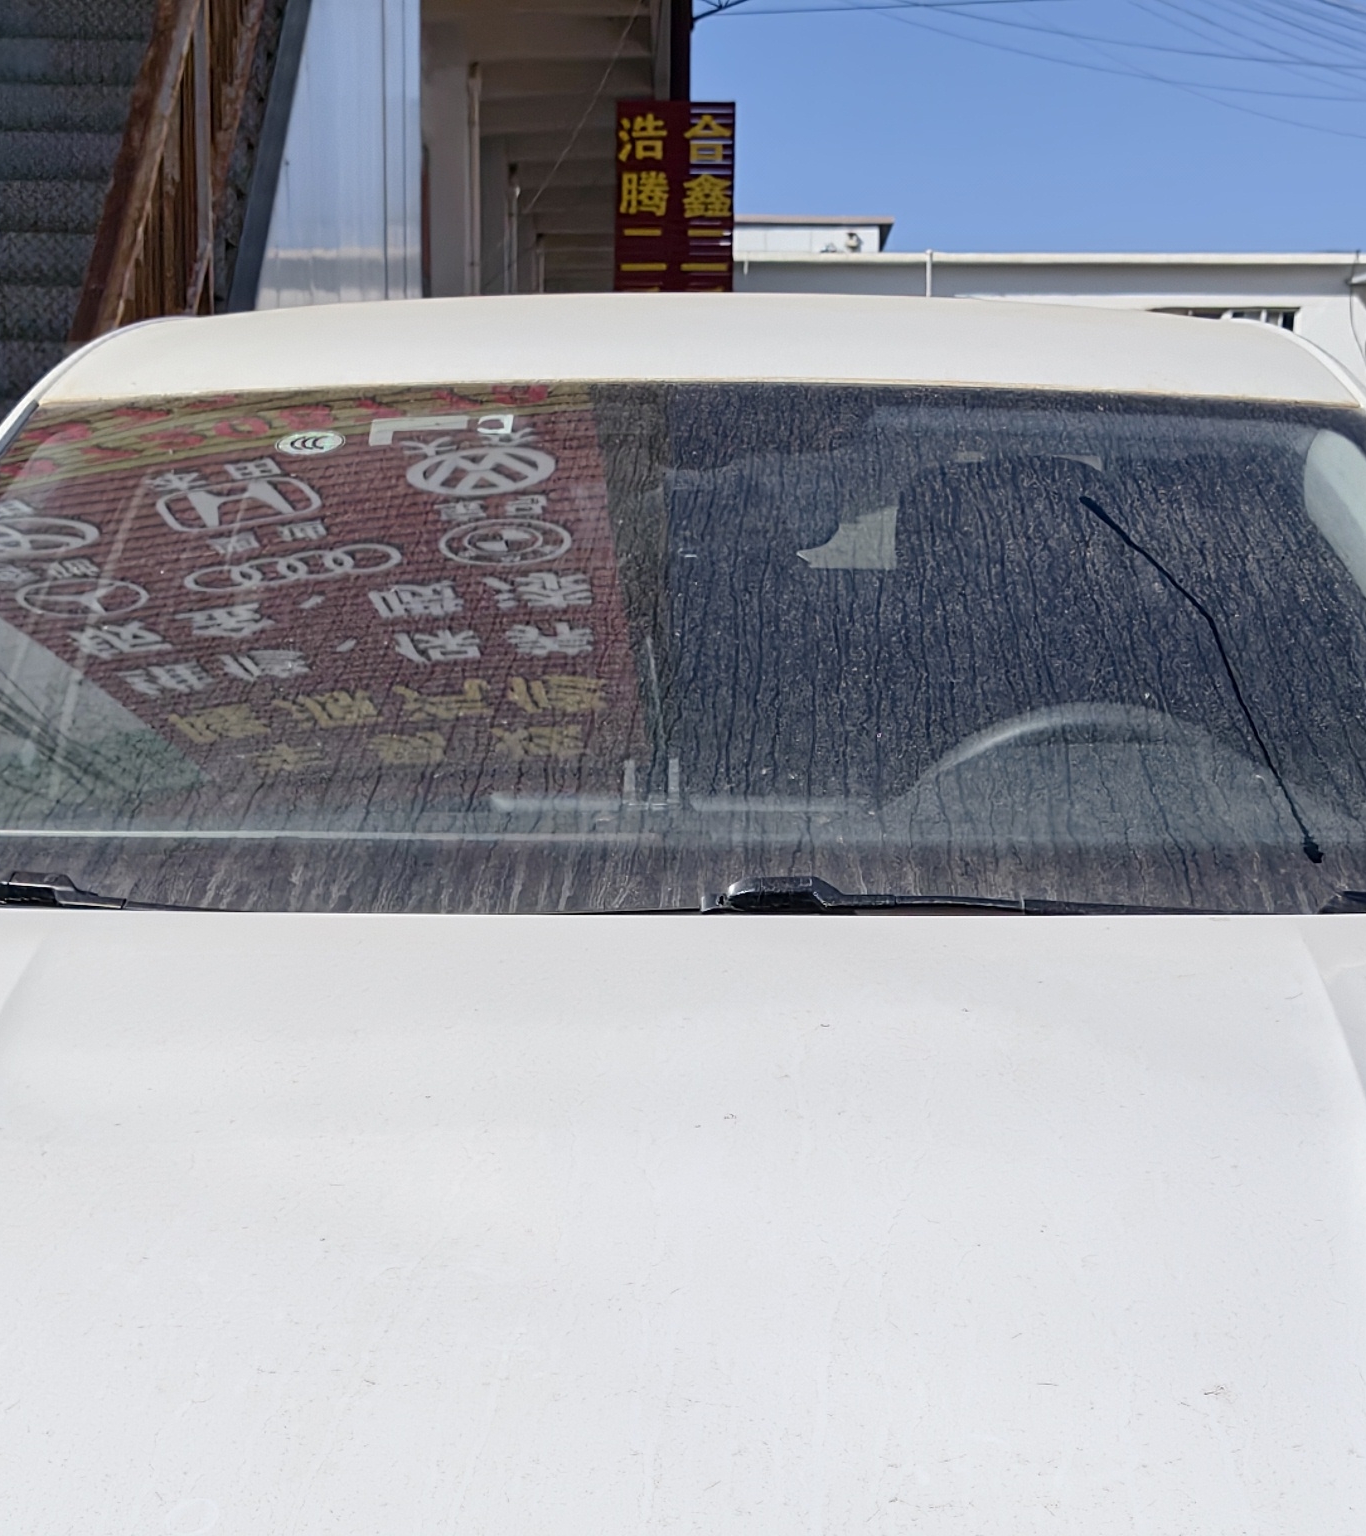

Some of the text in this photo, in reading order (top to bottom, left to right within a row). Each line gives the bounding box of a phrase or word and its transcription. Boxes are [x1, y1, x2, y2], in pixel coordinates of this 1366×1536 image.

[619, 113, 669, 291] 浩腾二
[681, 114, 733, 291] 合鑫二
